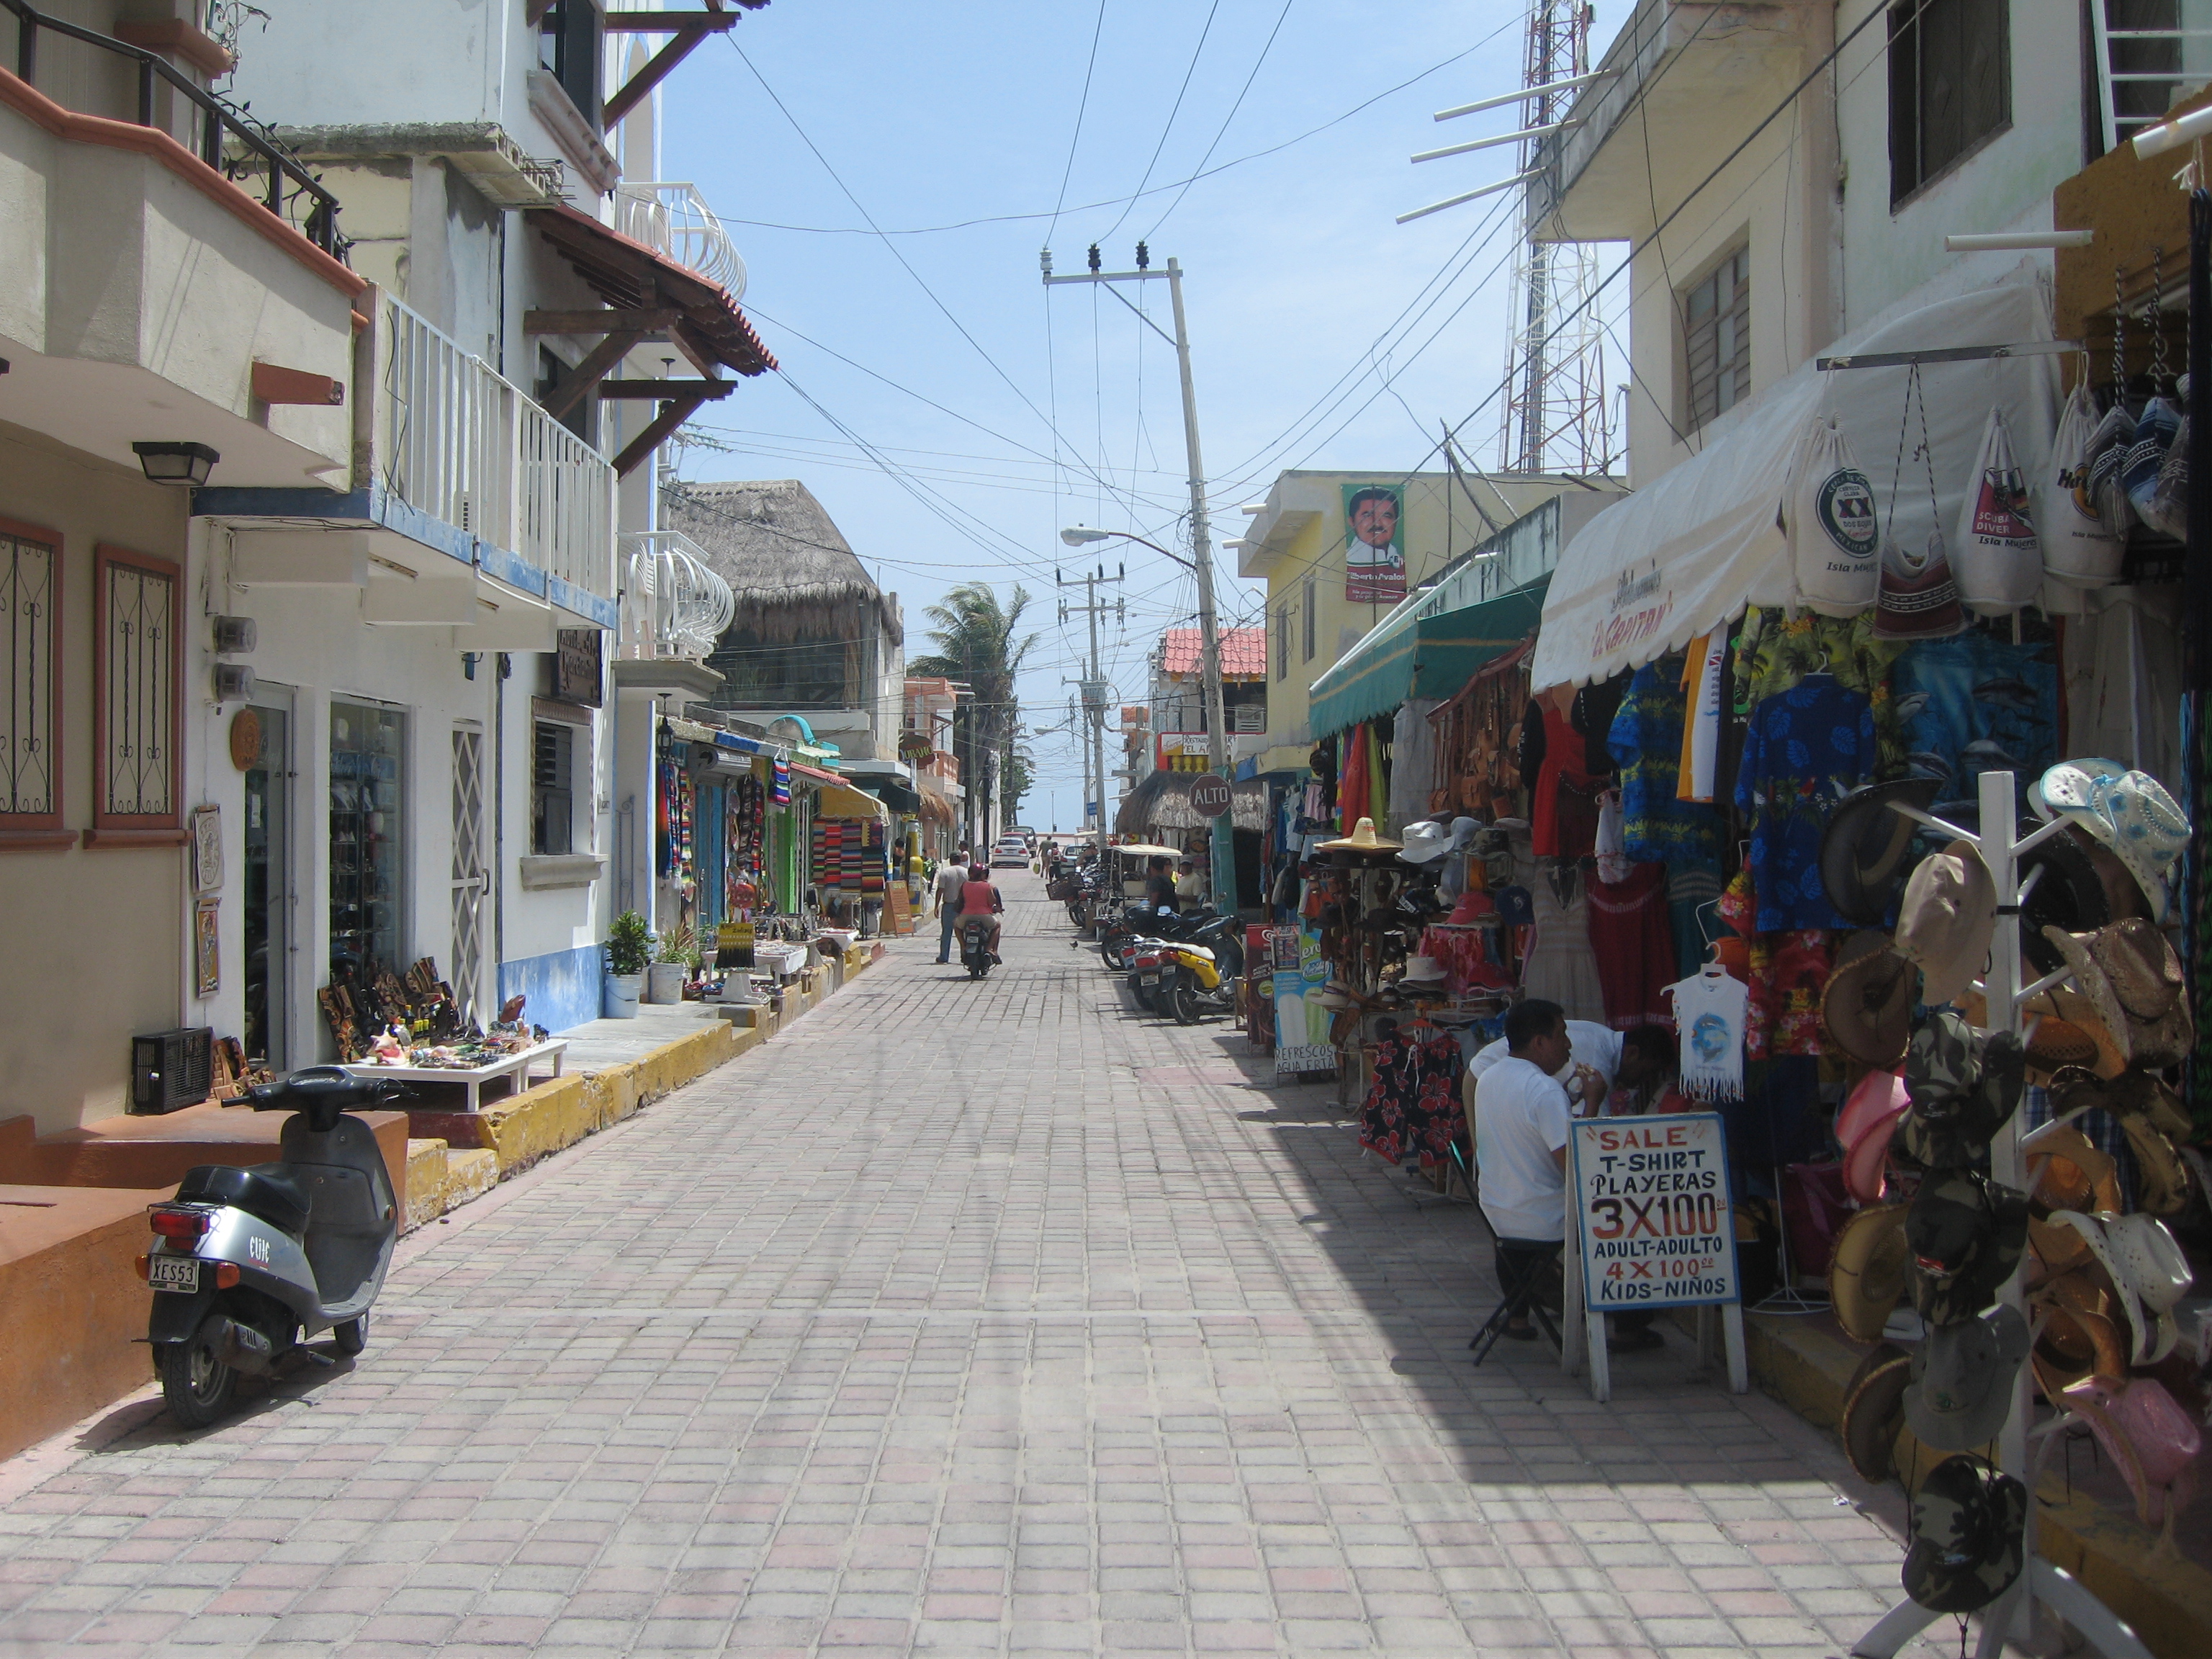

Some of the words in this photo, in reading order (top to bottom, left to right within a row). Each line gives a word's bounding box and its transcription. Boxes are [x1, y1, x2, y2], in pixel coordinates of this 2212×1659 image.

[1976, 522, 2010, 534] DIVER
[1978, 536, 2001, 546] Isla
[1827, 562, 1851, 572] Isla
[1194, 786, 1228, 805] ALTO
[1274, 1045, 1334, 1061] REFRESCOS
[1277, 1061, 1301, 1073] AGUA
[1599, 1150, 1706, 1174] T-SHIRT
[1590, 1171, 1716, 1199] PLAYERAS
[1594, 1236, 1723, 1259] ADULT-ADULTO
[153, 1262, 194, 1282] XES53
[1601, 1276, 1726, 1300] KIDS-NIÑOS
